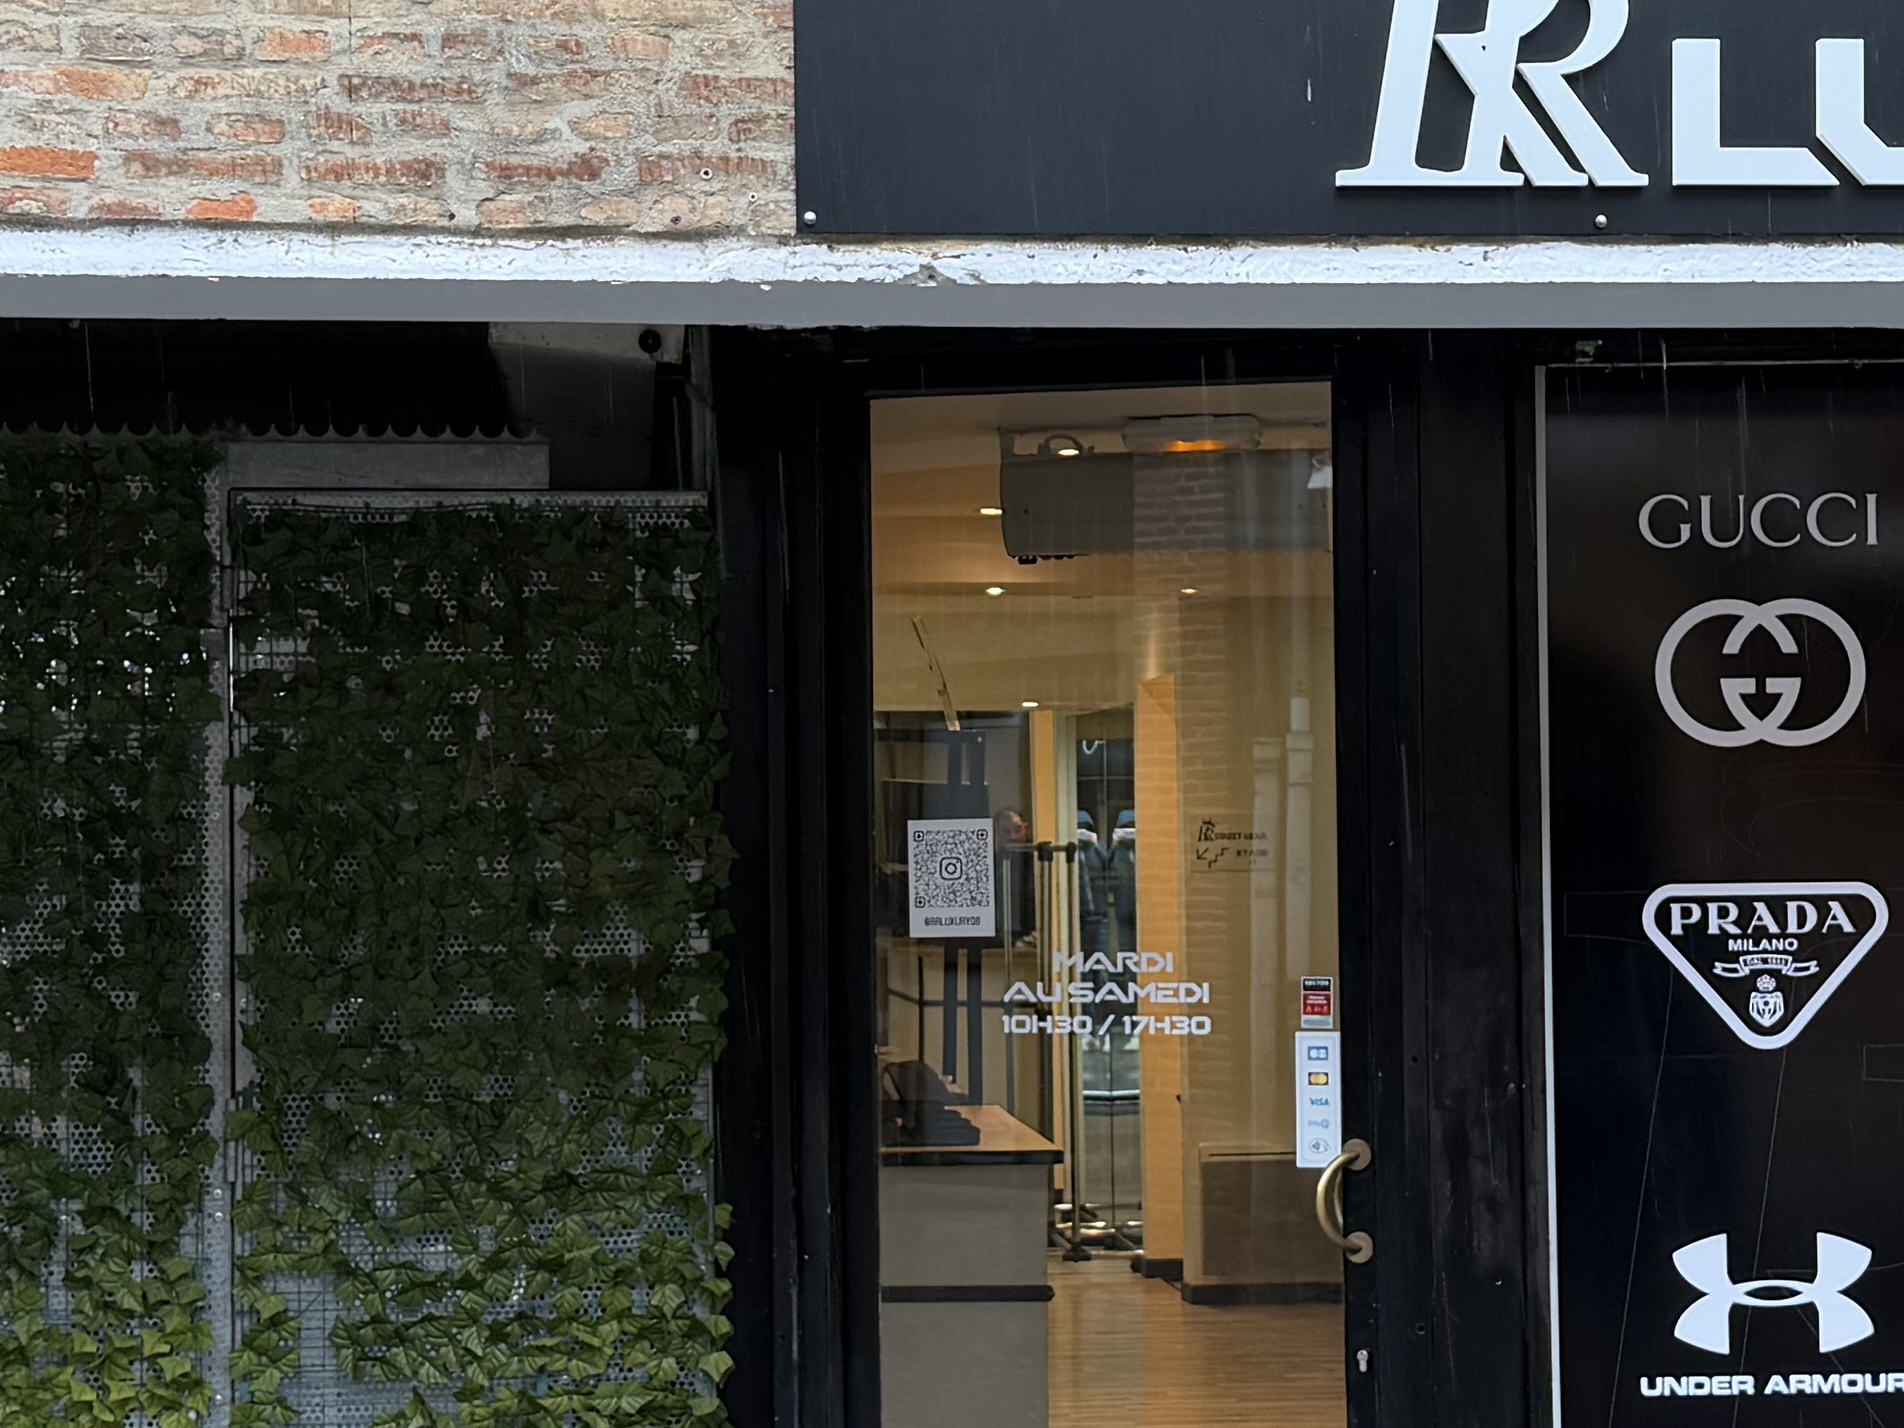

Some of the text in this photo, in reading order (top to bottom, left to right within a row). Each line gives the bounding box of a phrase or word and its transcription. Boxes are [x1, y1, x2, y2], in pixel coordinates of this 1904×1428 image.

[1638, 492, 1879, 549] GUCCI
[1669, 900, 1857, 935] PRADA
[1728, 938, 1799, 952] MILANO
[1052, 951, 1175, 973] MARDI
[1003, 981, 1211, 1005] AU SAMEDI
[1001, 1014, 1093, 1035] 10H30
[1121, 1015, 1212, 1036] 17H30
[1309, 1098, 1329, 1106] VISA
[1640, 1375, 1755, 1397] UNDER
